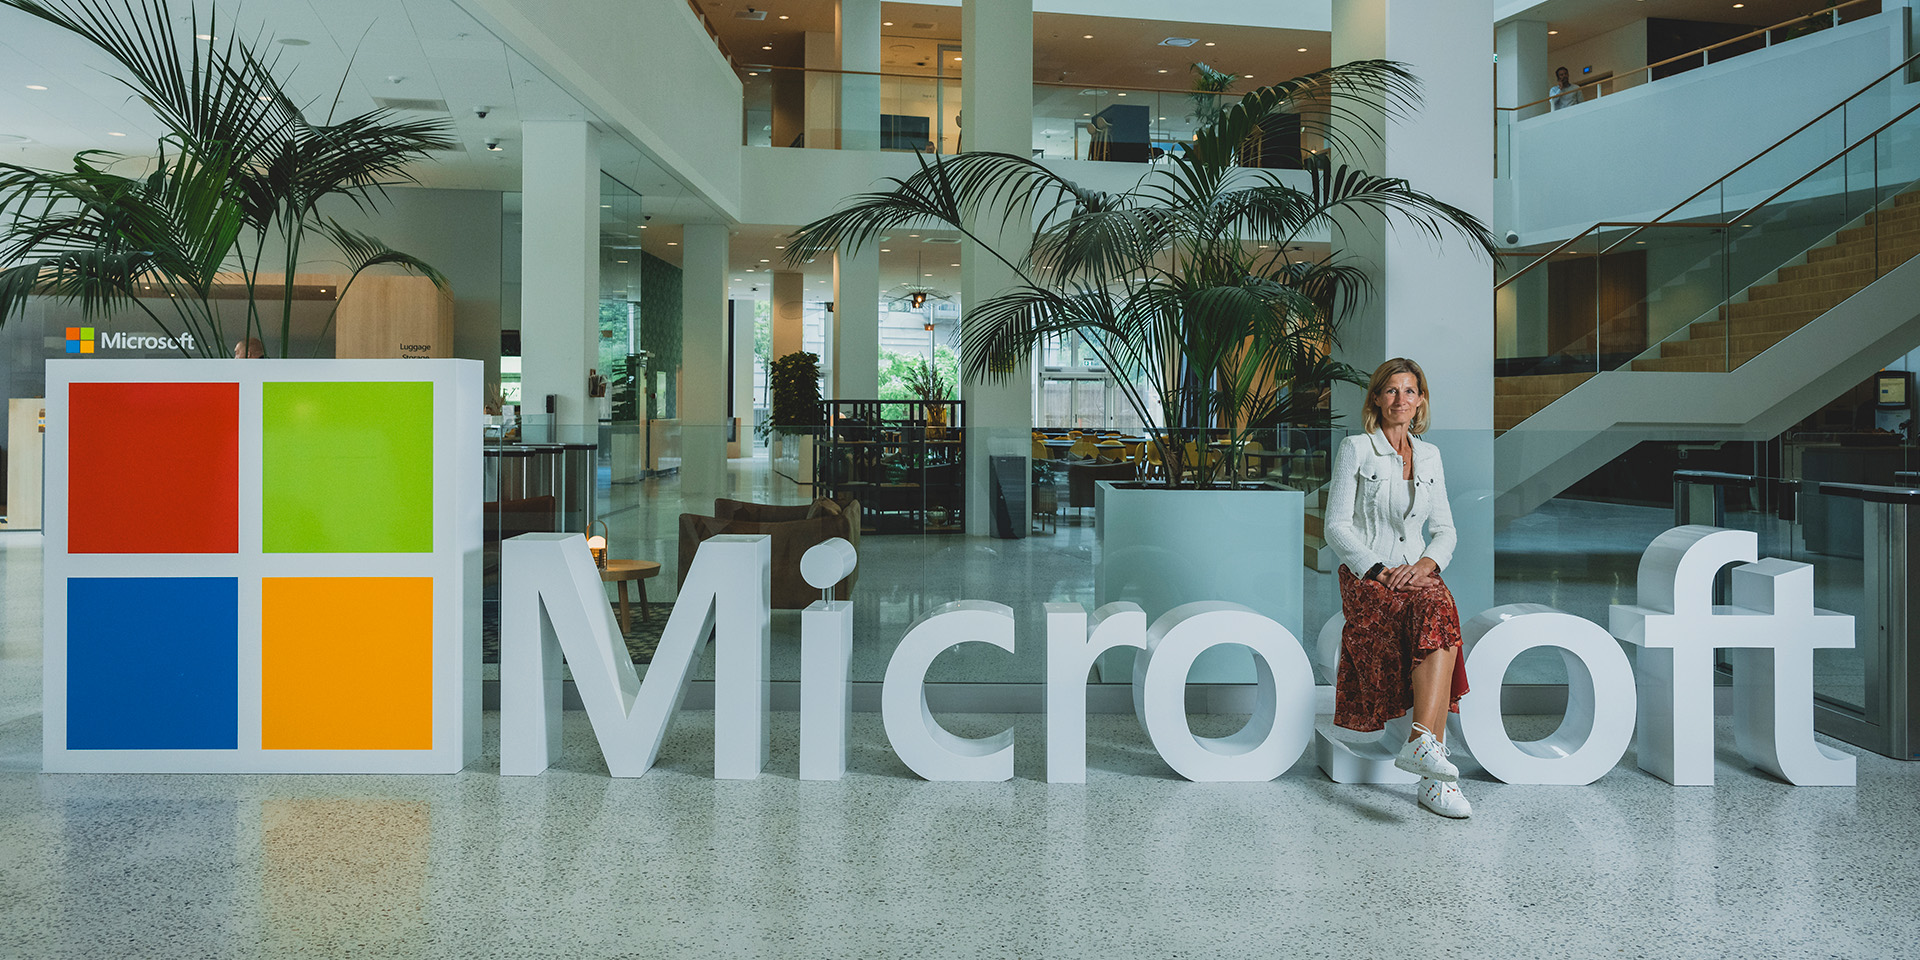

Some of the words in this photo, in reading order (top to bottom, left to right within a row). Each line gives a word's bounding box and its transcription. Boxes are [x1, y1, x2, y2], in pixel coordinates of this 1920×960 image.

[101, 332, 194, 350] Microsoft
[400, 343, 431, 352] Luggage
[500, 525, 1857, 786] Microoft
